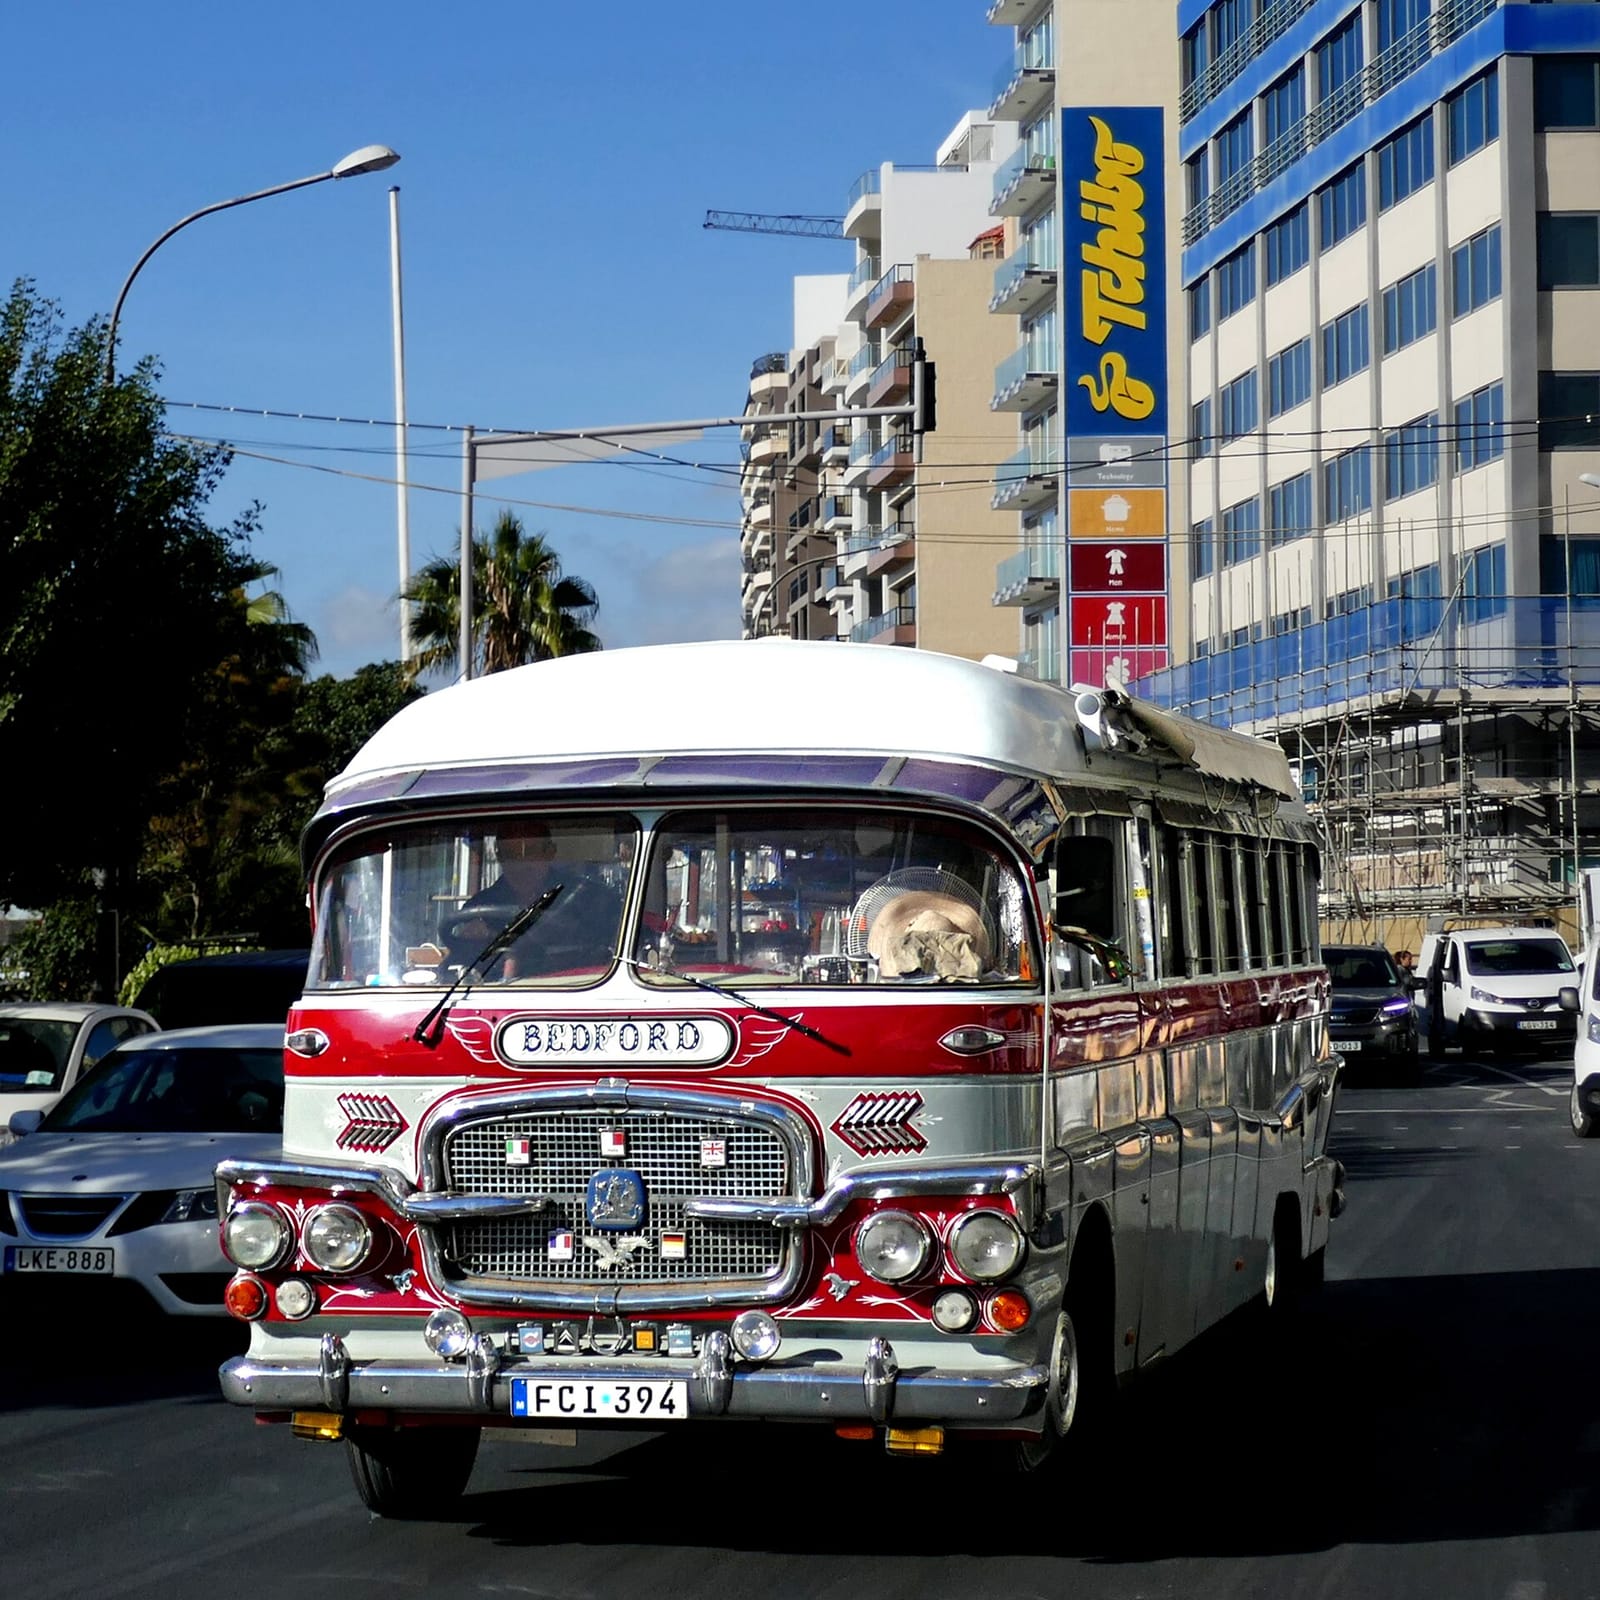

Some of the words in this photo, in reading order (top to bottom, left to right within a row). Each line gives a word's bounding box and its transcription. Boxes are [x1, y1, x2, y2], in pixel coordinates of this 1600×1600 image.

[1080, 115, 1146, 345] Tchibo
[1097, 472, 1134, 481] Technology
[522, 1022, 700, 1052] BEDFORD
[18, 1250, 57, 1269] LKE
[66, 1250, 106, 1270] 888
[535, 1385, 597, 1413] FCI
[614, 1385, 676, 1414] 394
